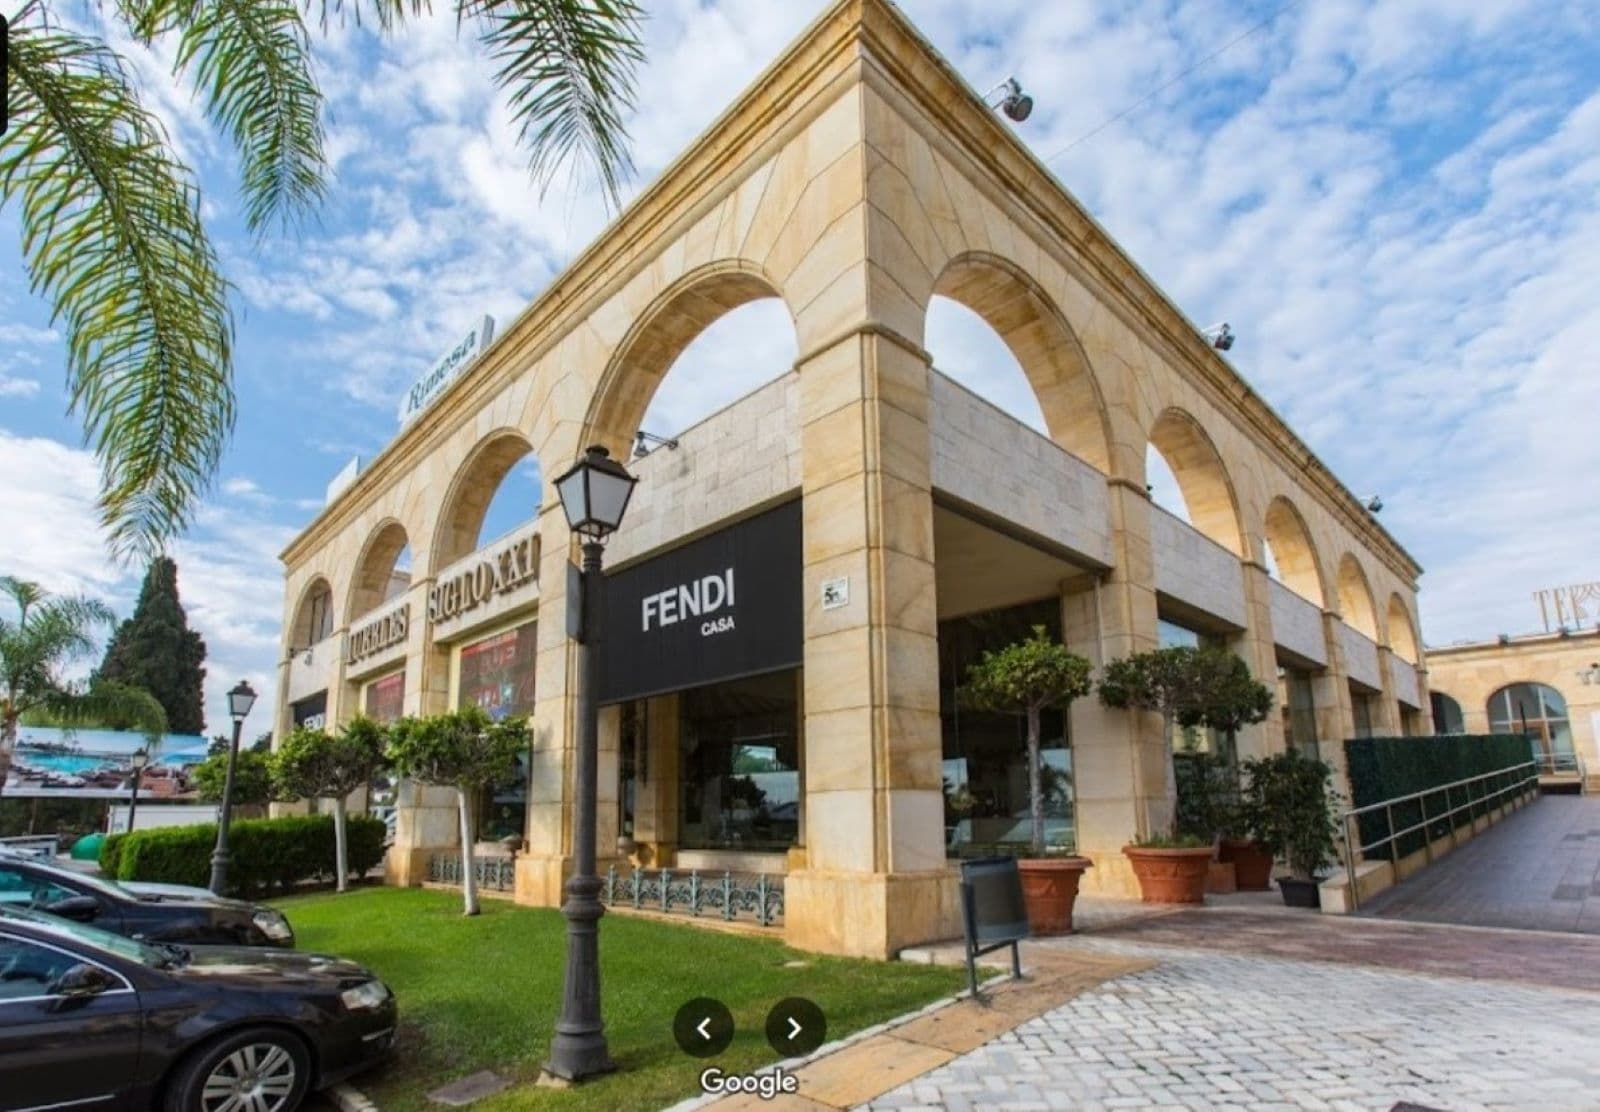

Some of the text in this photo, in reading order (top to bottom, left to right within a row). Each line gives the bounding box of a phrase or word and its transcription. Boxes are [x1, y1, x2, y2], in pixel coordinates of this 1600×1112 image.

[428, 533, 539, 619] SIGLO XXI
[642, 567, 735, 632] FENDI
[701, 615, 736, 637] CASA
